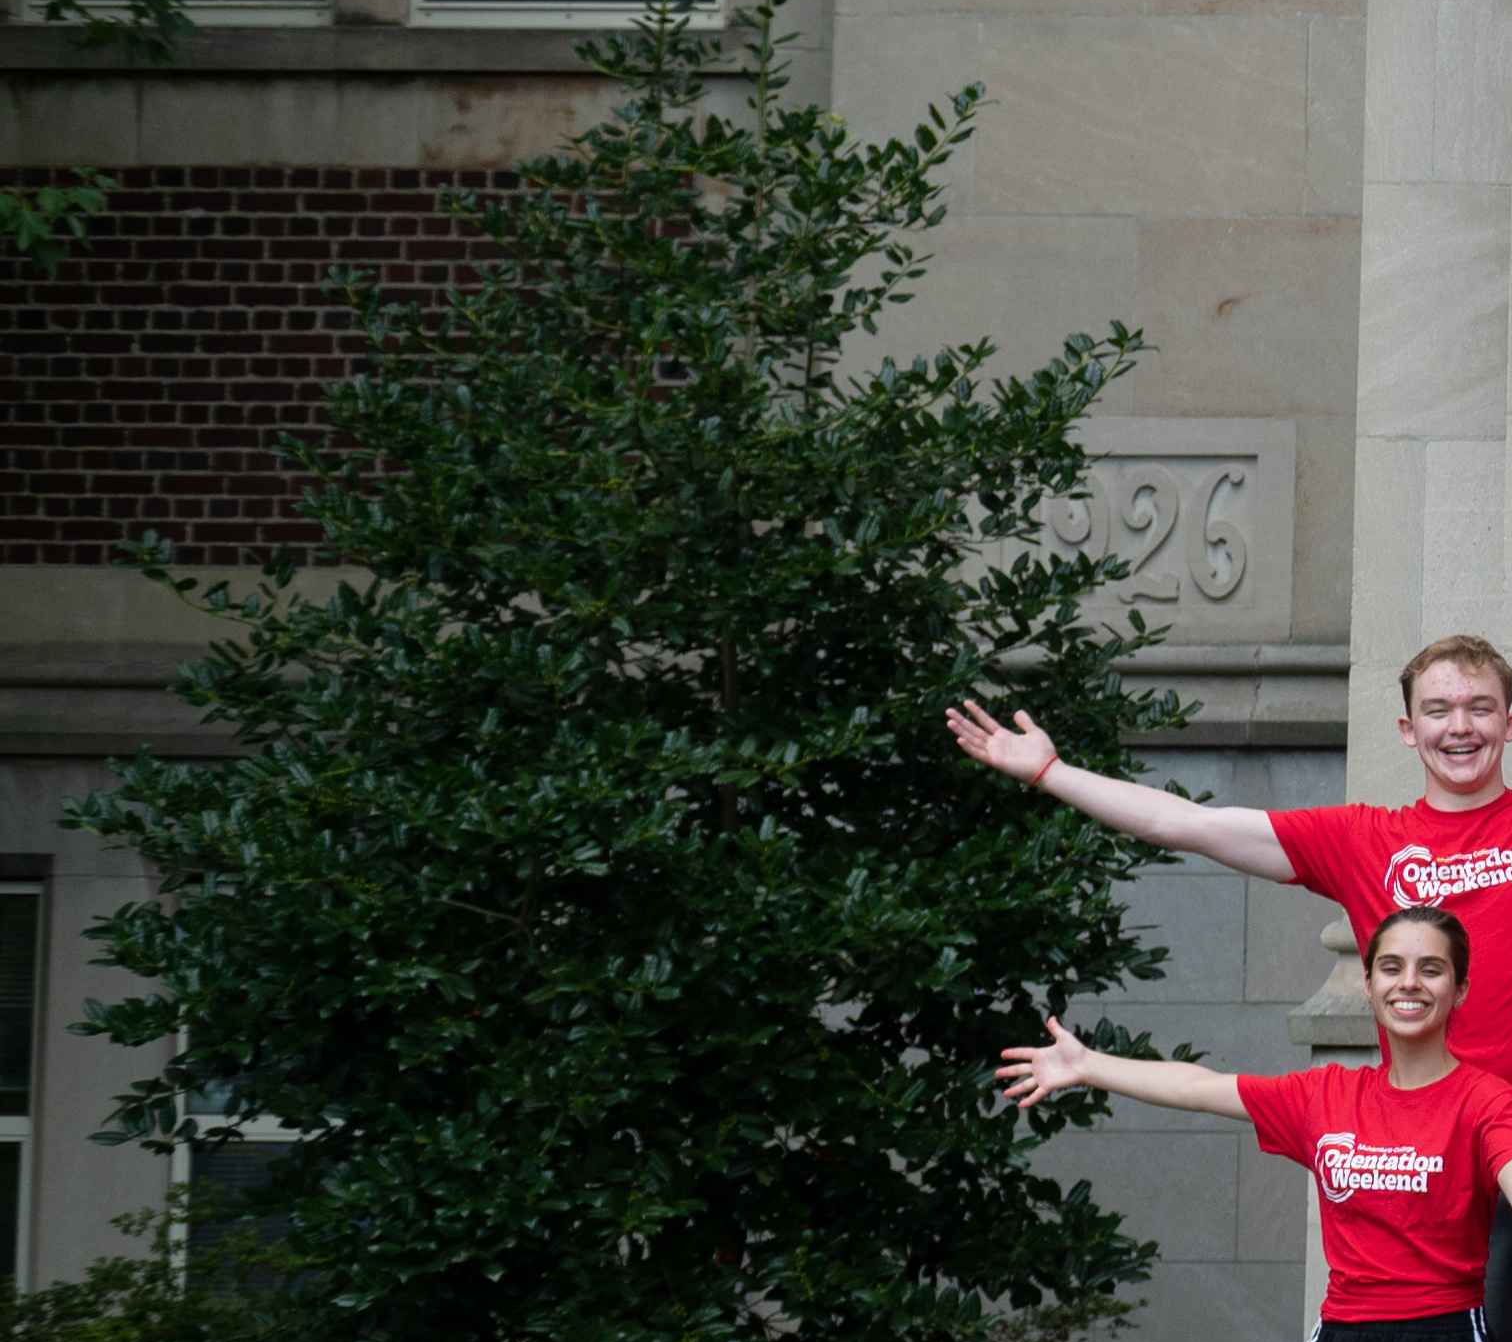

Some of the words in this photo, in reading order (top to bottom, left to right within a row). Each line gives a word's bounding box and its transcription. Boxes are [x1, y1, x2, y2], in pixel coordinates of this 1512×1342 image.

[1045, 464, 1247, 603] 926
[1324, 1148, 1444, 1173] Orientation
[1330, 1167, 1429, 1194] Weekend
